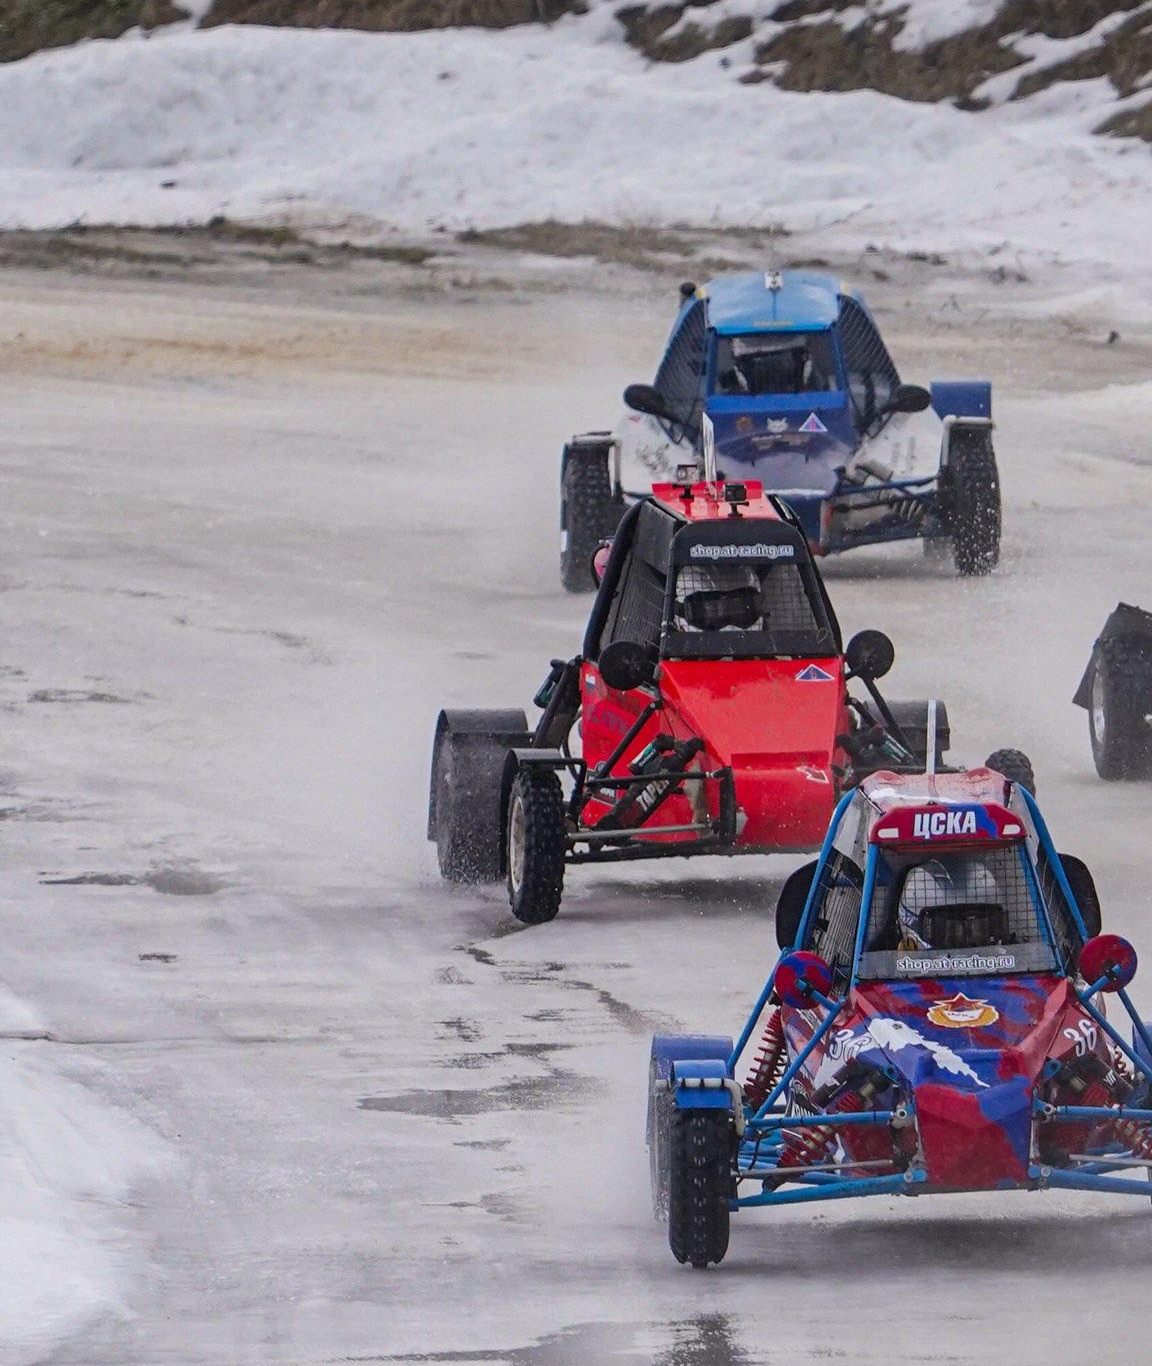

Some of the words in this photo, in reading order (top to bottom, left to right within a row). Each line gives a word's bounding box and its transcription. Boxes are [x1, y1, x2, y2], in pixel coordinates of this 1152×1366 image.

[690, 543, 794, 559] shop.at-racing.ru
[913, 811, 977, 839] ЦСКА
[896, 955, 1015, 973] shop.at-racing.ru
[829, 1029, 872, 1065] 36
[1063, 1019, 1097, 1057] 36
